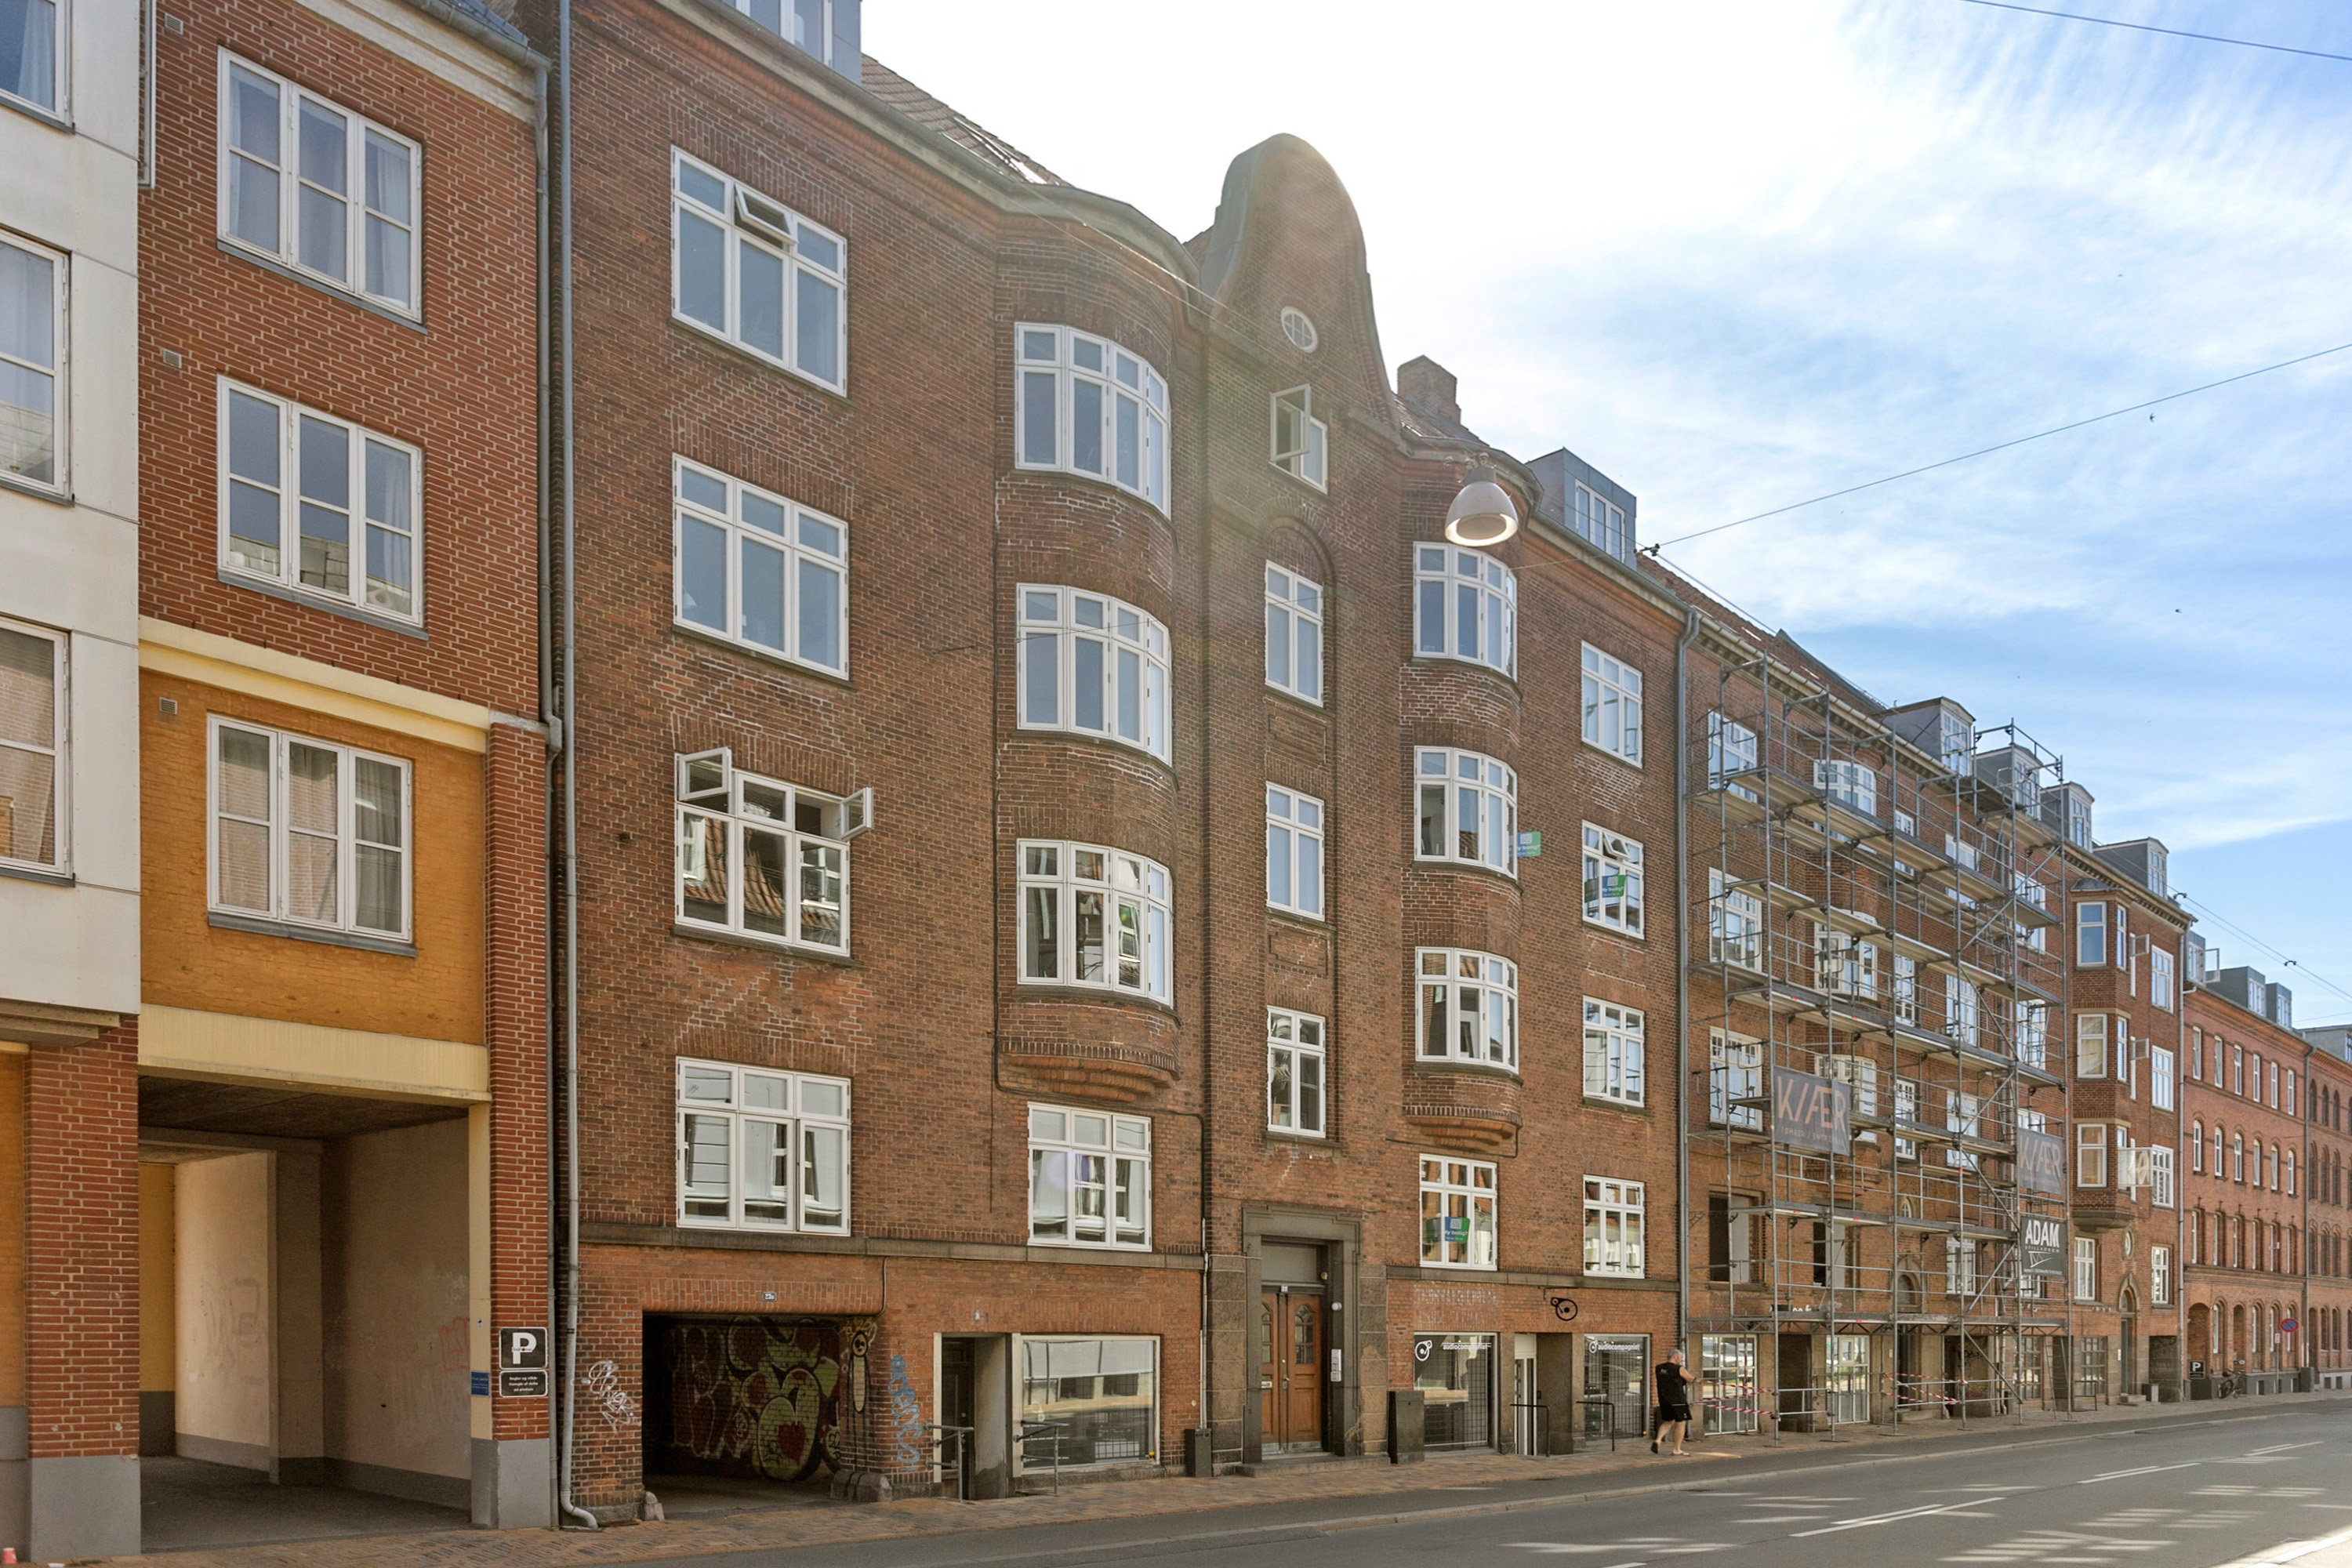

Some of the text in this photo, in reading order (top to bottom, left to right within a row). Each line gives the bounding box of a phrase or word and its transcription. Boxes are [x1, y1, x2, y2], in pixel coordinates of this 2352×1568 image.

[2025, 1219, 2060, 1248] ADAM
[512, 1332, 537, 1364] P
[2192, 1362, 2201, 1371] P
